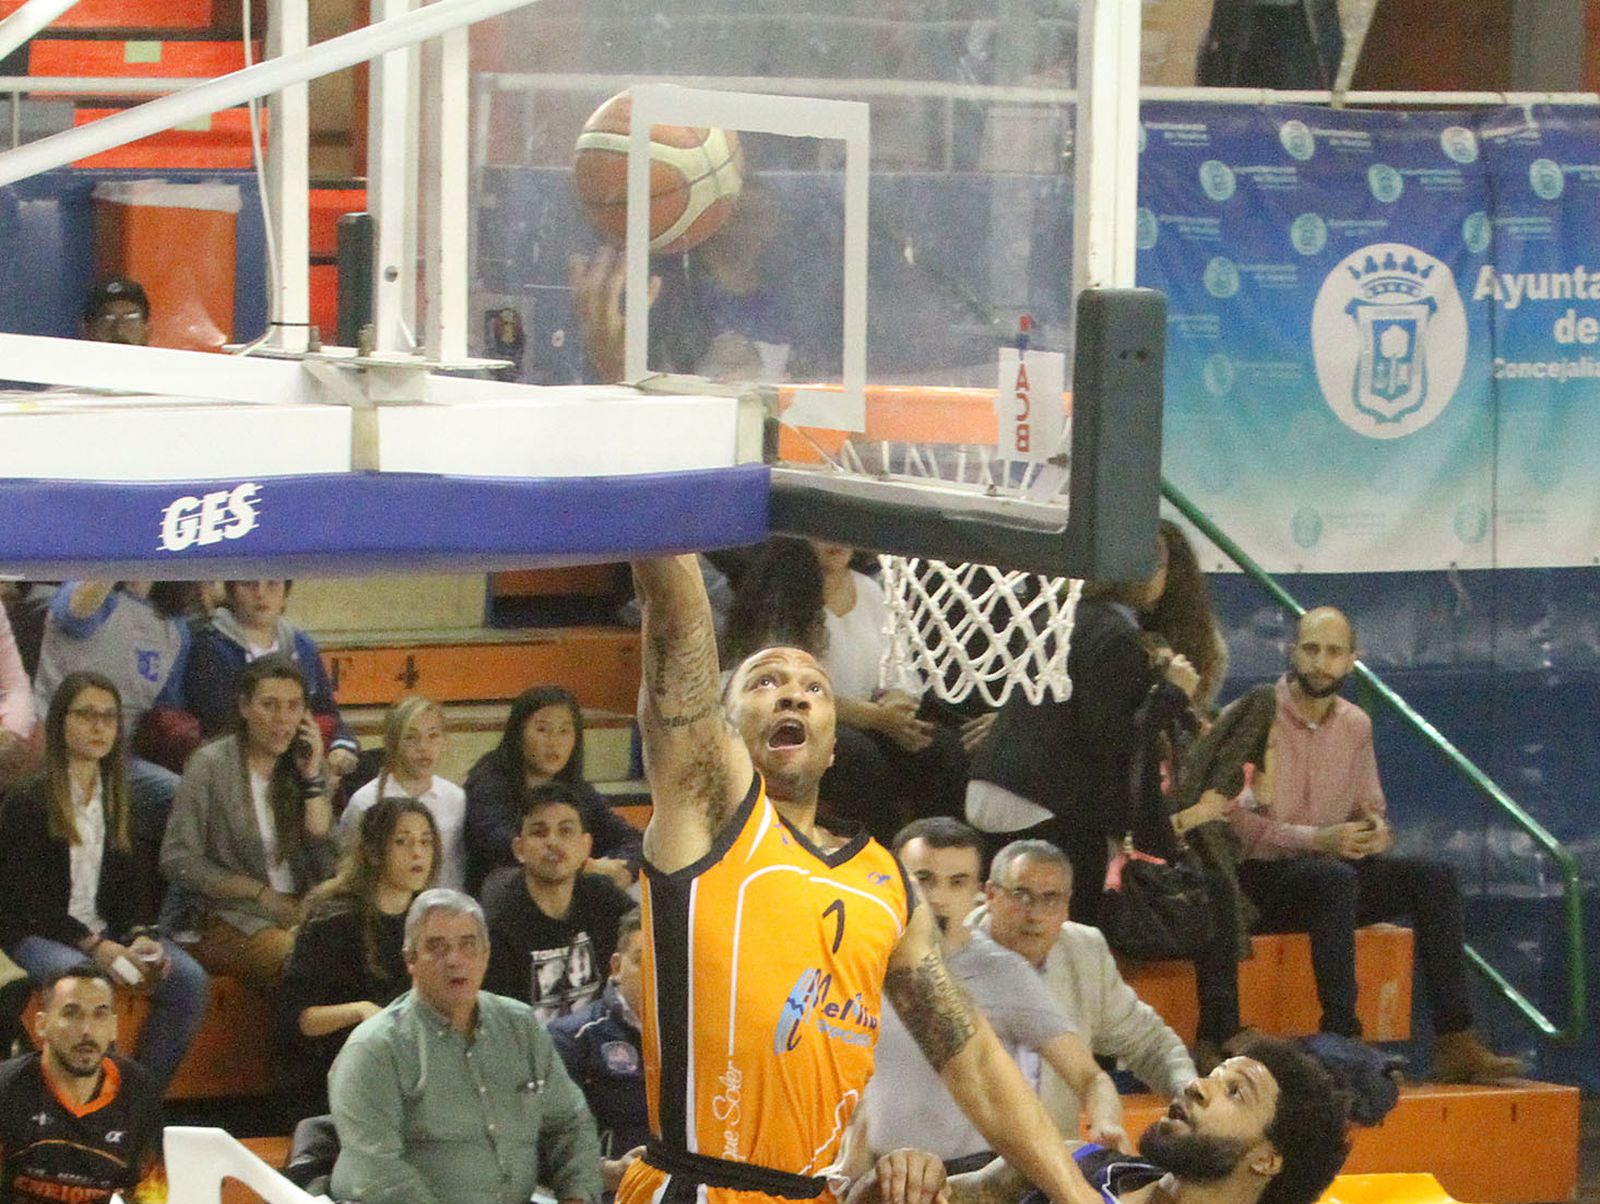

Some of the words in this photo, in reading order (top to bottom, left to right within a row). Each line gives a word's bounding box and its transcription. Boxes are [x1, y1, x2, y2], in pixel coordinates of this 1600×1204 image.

[1553, 308, 1599, 345] de
[156, 482, 264, 552] GES
[711, 1060, 743, 1127] Soler
